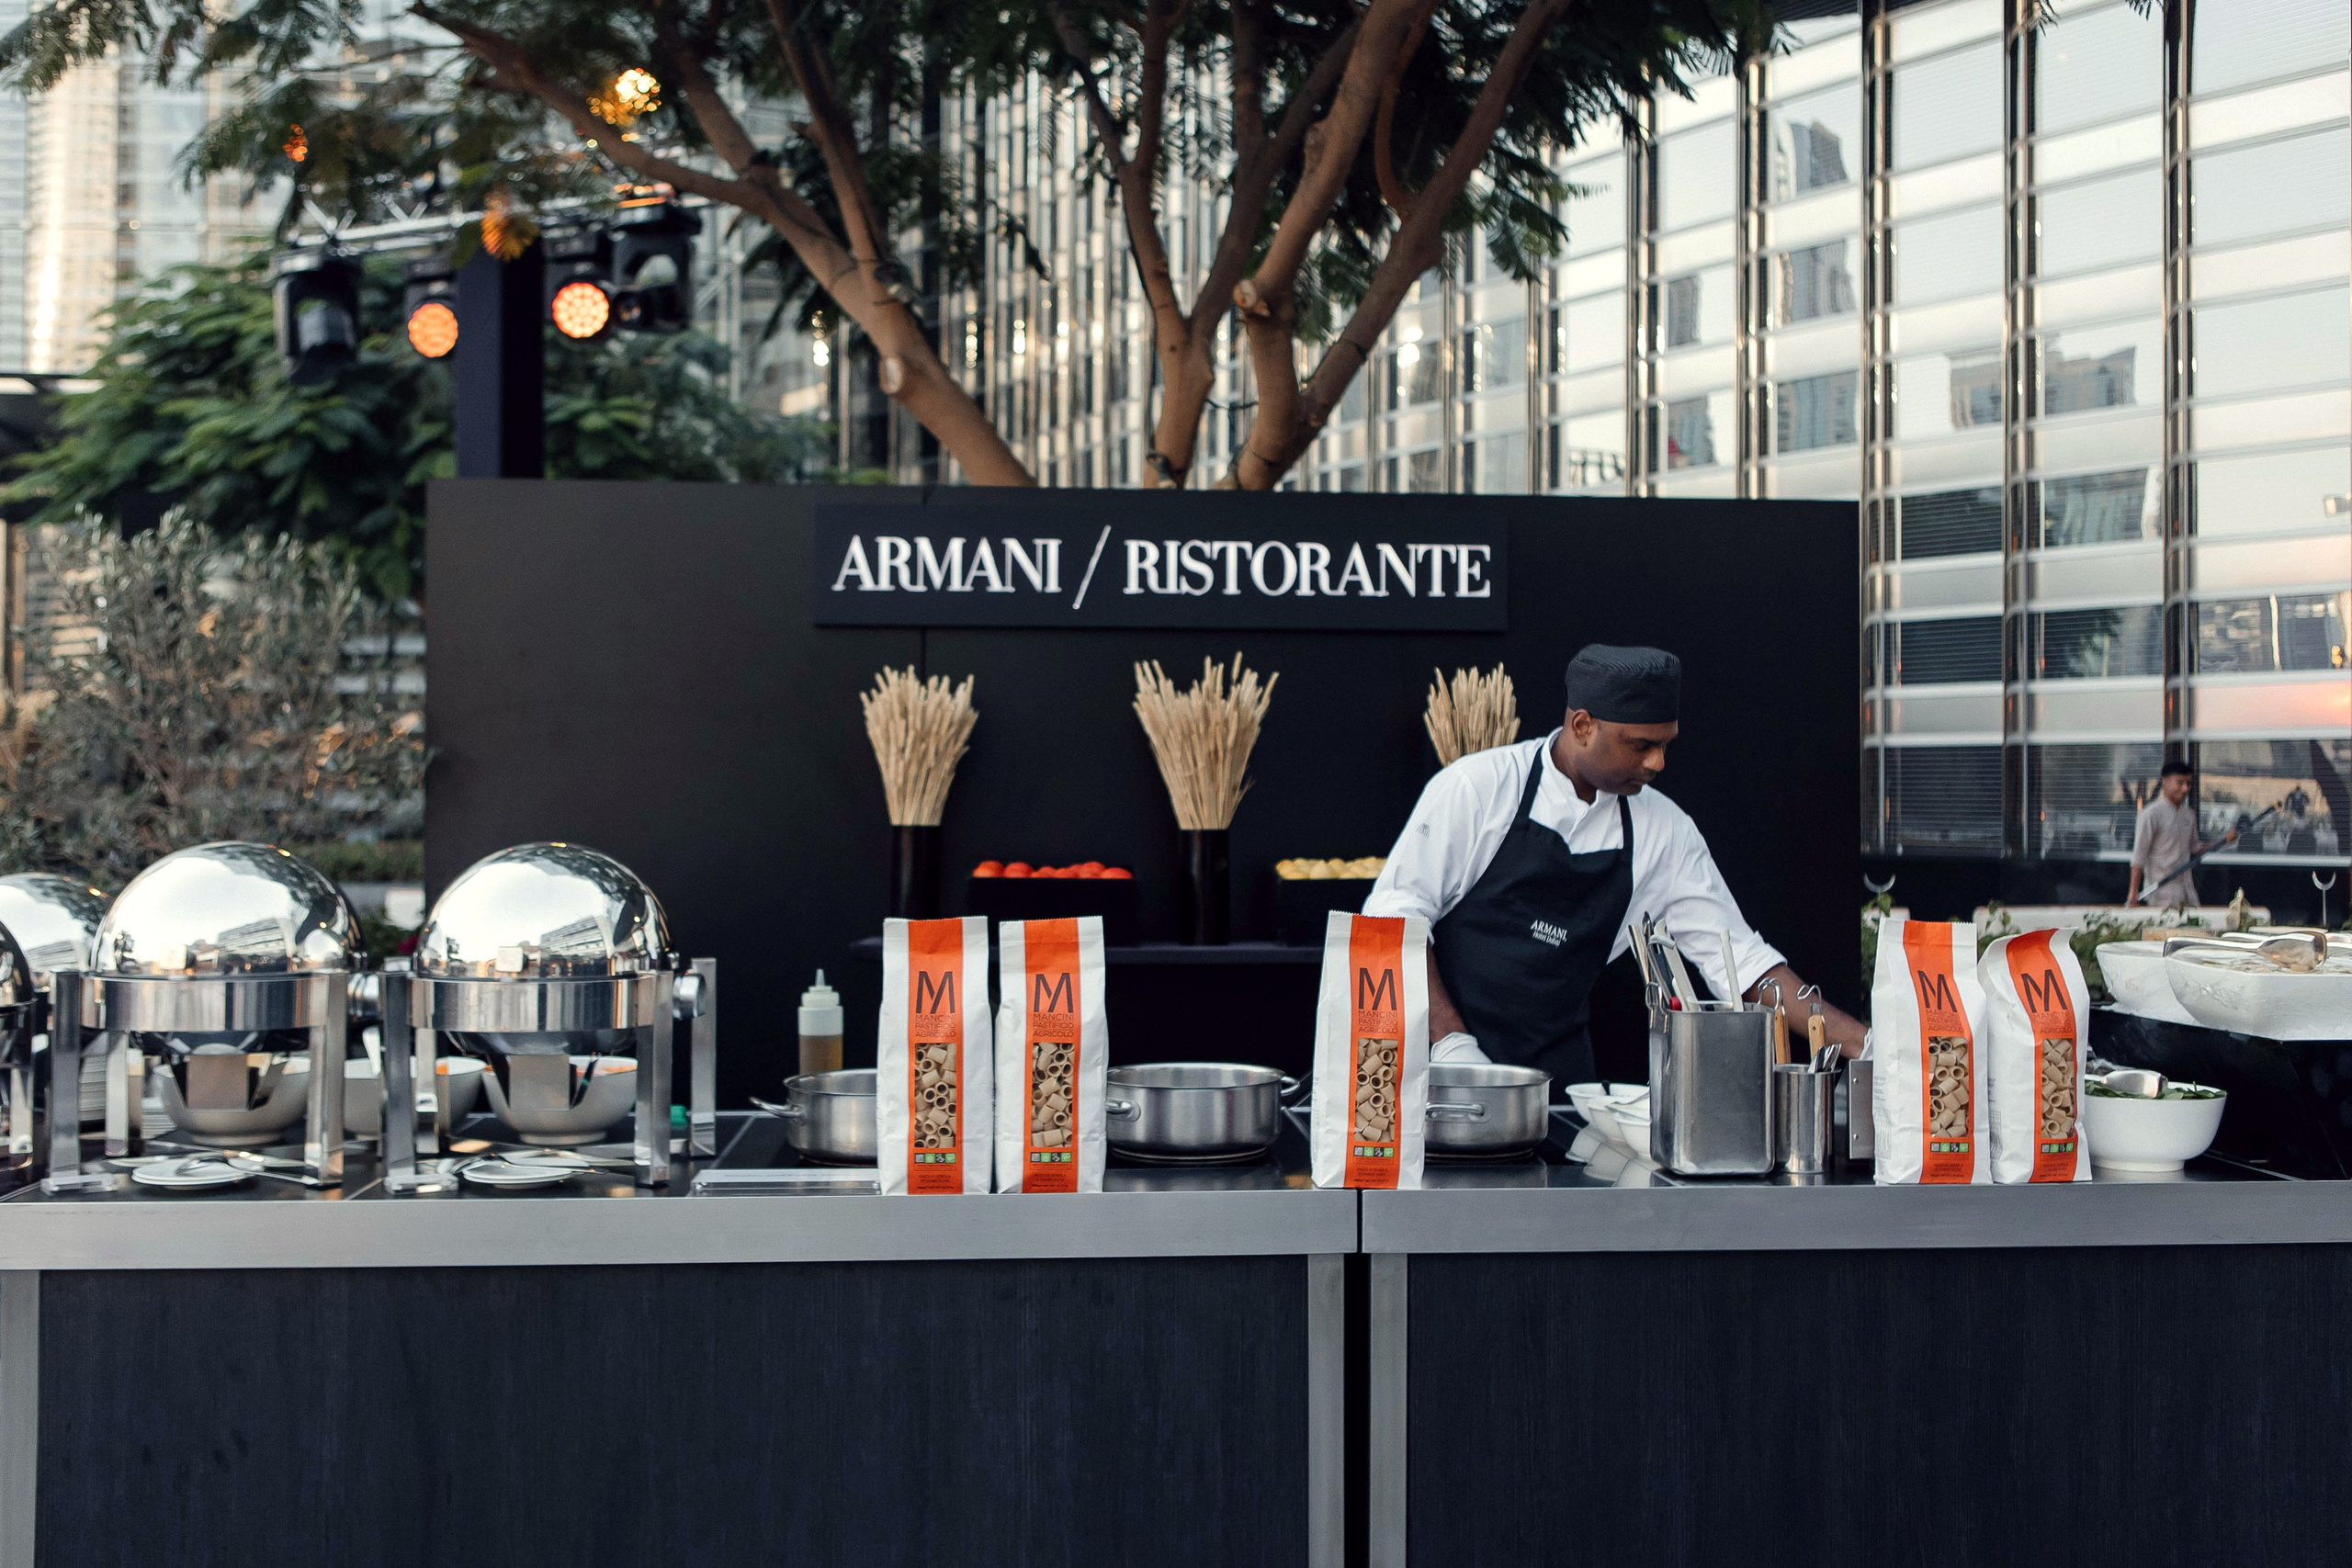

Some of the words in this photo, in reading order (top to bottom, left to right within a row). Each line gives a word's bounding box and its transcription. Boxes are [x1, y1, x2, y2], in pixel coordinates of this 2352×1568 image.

[831, 534, 1063, 594] ARMANI
[1123, 538, 1492, 599] RISTORANTE
[1530, 919, 1567, 941] ARMANI
[915, 971, 956, 1014] M
[1034, 973, 1074, 1013] M
[1358, 967, 1397, 1010] M
[1917, 970, 1958, 1013] M
[2020, 969, 2068, 1013] M
[915, 1021, 956, 1030] PASTIFICIO
[1033, 1013, 1074, 1021] MANCINI
[1033, 1021, 1074, 1030] PASTIFICIO
[1358, 1010, 1397, 1019] MANCINI
[915, 1030, 956, 1038] AGRICOLO
[1358, 1026, 1397, 1034] AGRICOLO
